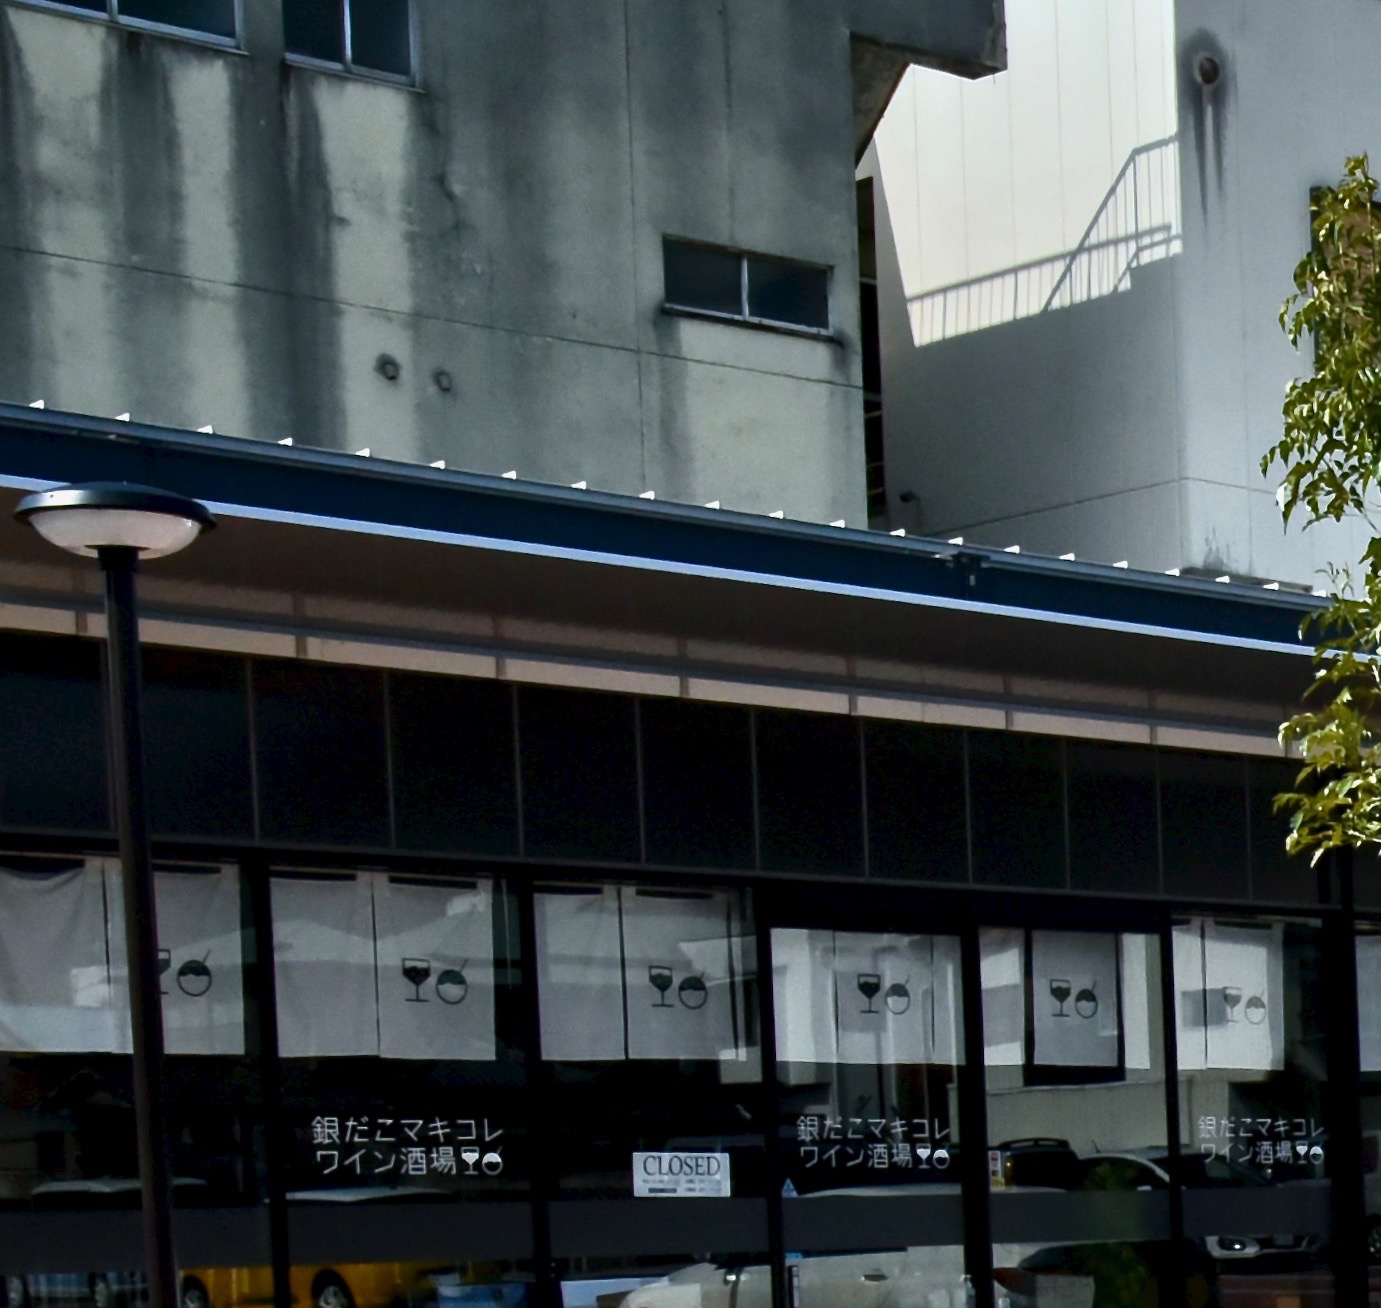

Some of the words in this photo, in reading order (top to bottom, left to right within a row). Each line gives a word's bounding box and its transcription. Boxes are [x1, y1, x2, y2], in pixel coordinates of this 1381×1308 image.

[311, 1115, 503, 1145] 銀だこマキコレ
[796, 1115, 950, 1142] 銀だこマキコレ
[1198, 1116, 1325, 1138] 銀だこマキコレ
[316, 1146, 457, 1175] ワイン酒場
[801, 1143, 913, 1169] ワイン酒場
[1201, 1140, 1293, 1164] ワイン酒場
[643, 1155, 721, 1176] CLOSED
